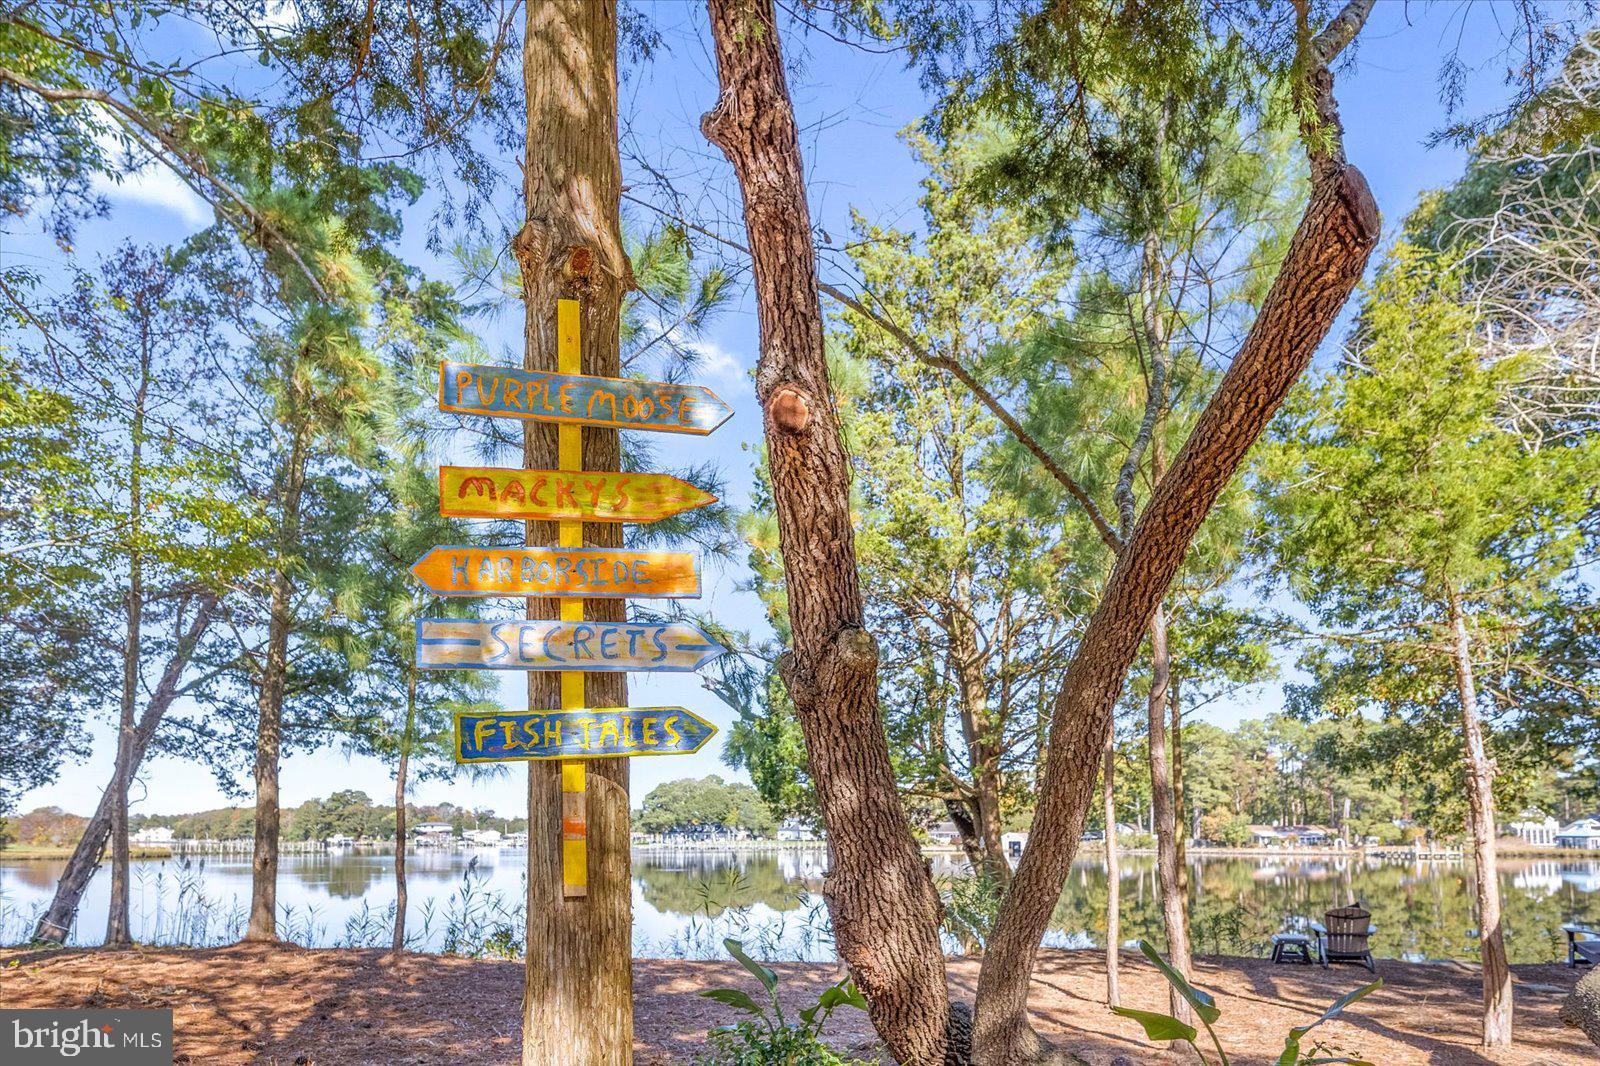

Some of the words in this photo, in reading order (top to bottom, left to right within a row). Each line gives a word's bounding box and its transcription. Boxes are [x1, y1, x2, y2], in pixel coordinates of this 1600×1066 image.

[456, 371, 573, 414] PURPLE
[587, 389, 697, 424] MOOSE
[458, 476, 630, 511] MACKYS
[451, 556, 650, 588] HARBORSIDE
[489, 623, 667, 662] SECRETS
[473, 718, 562, 751] FISH
[573, 715, 681, 751] TALES
